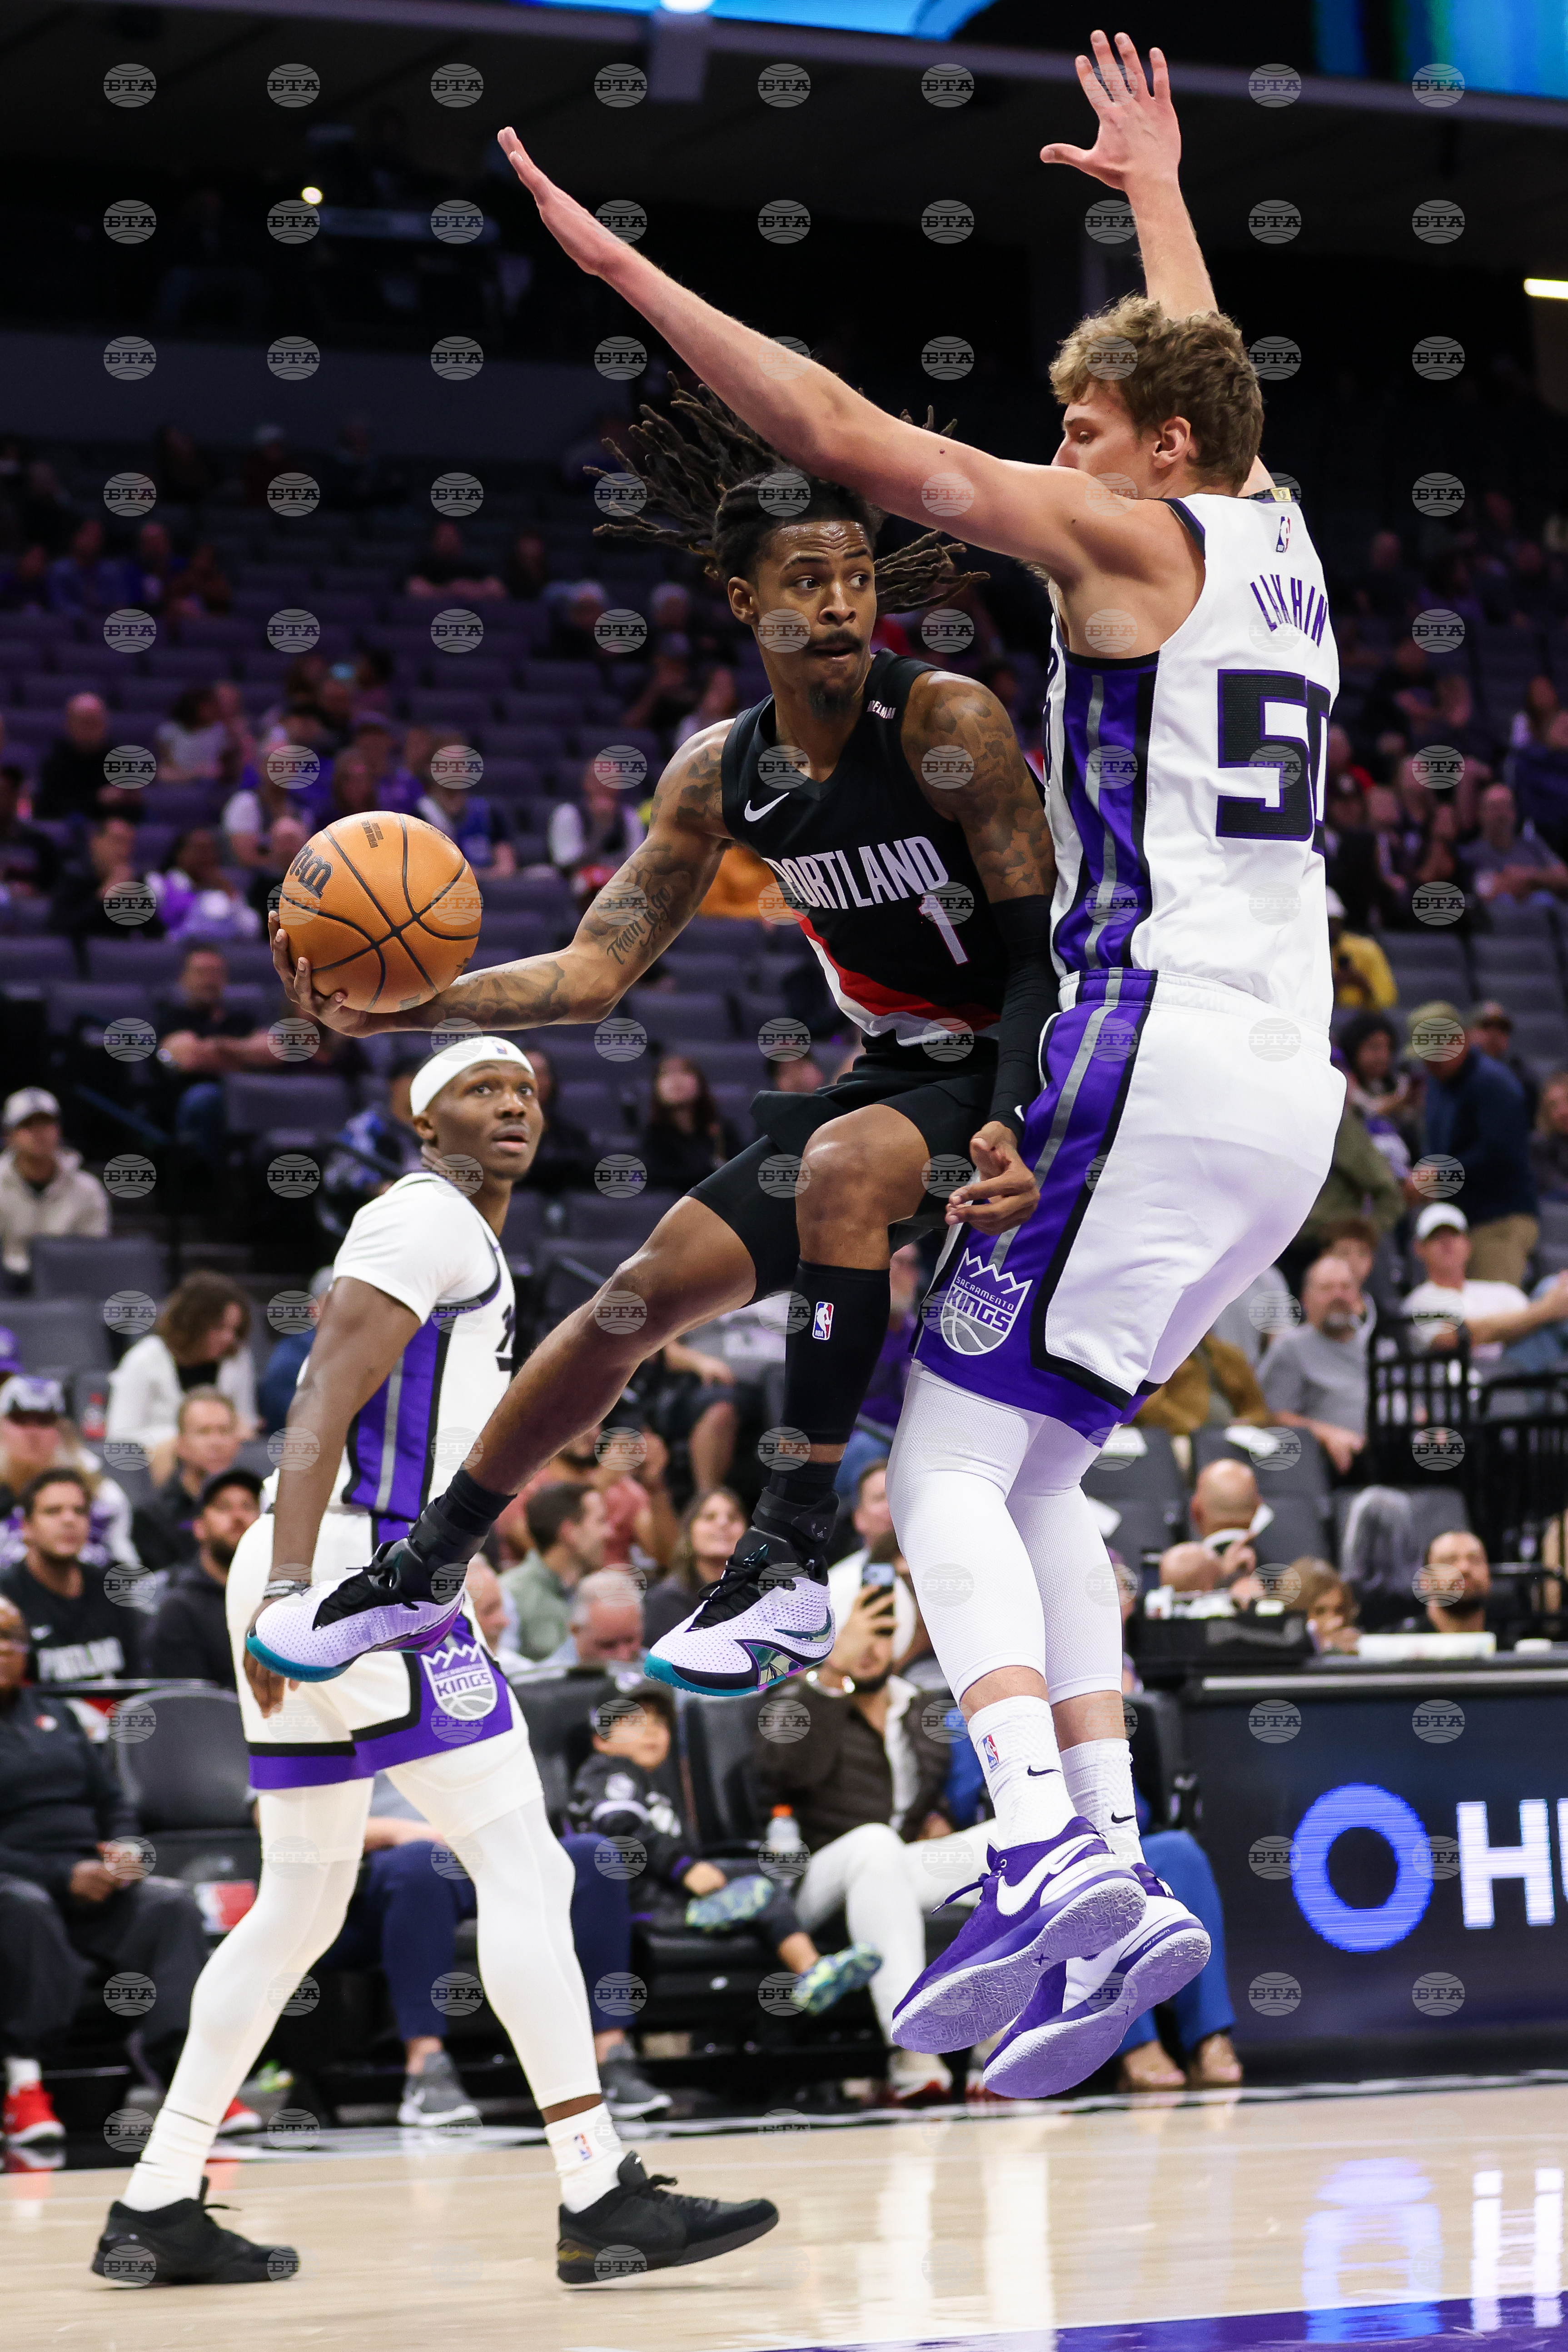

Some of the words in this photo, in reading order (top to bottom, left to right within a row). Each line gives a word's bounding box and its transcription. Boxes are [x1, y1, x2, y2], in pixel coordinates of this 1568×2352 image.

[1216, 668, 1331, 860] 50
[761, 836, 949, 909] PORTLAND
[919, 894, 969, 965] 1
[947, 1286, 1013, 1333] KINGS
[956, 1276, 1015, 1311] SACRAMENTO
[436, 1672, 492, 1697] KINGS
